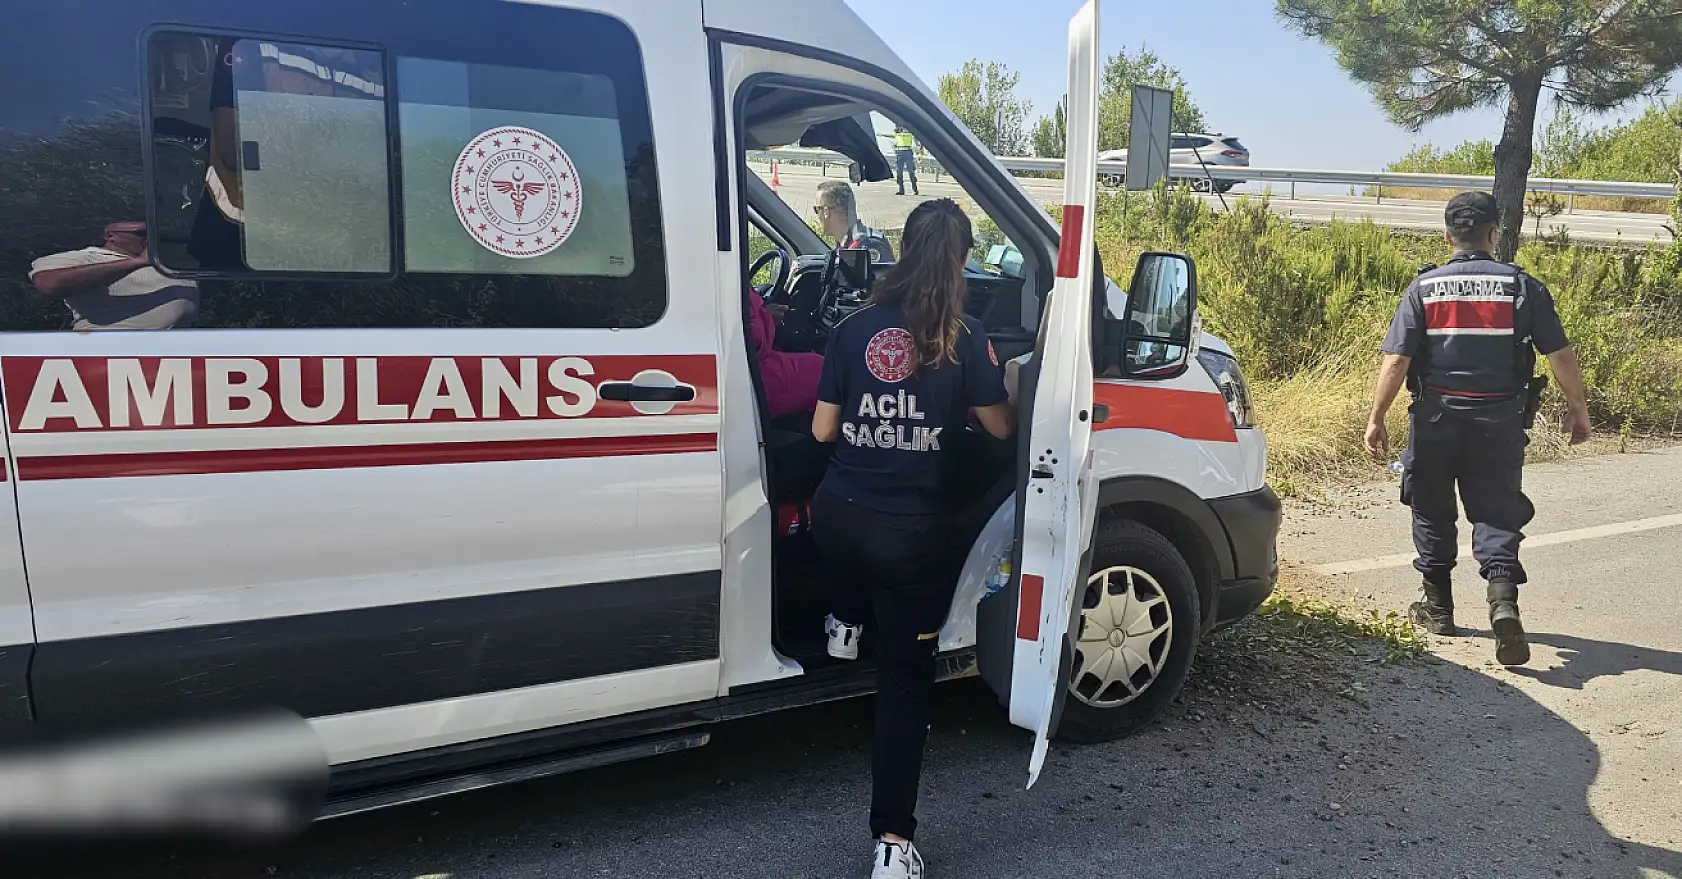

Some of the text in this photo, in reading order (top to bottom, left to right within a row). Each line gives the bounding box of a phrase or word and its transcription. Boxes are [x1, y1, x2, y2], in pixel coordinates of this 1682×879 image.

[1430, 280, 1504, 296] JANDARMA
[18, 357, 595, 429] AMBULANS
[857, 389, 925, 420] ACİL
[842, 420, 943, 451] SAĞLIK
